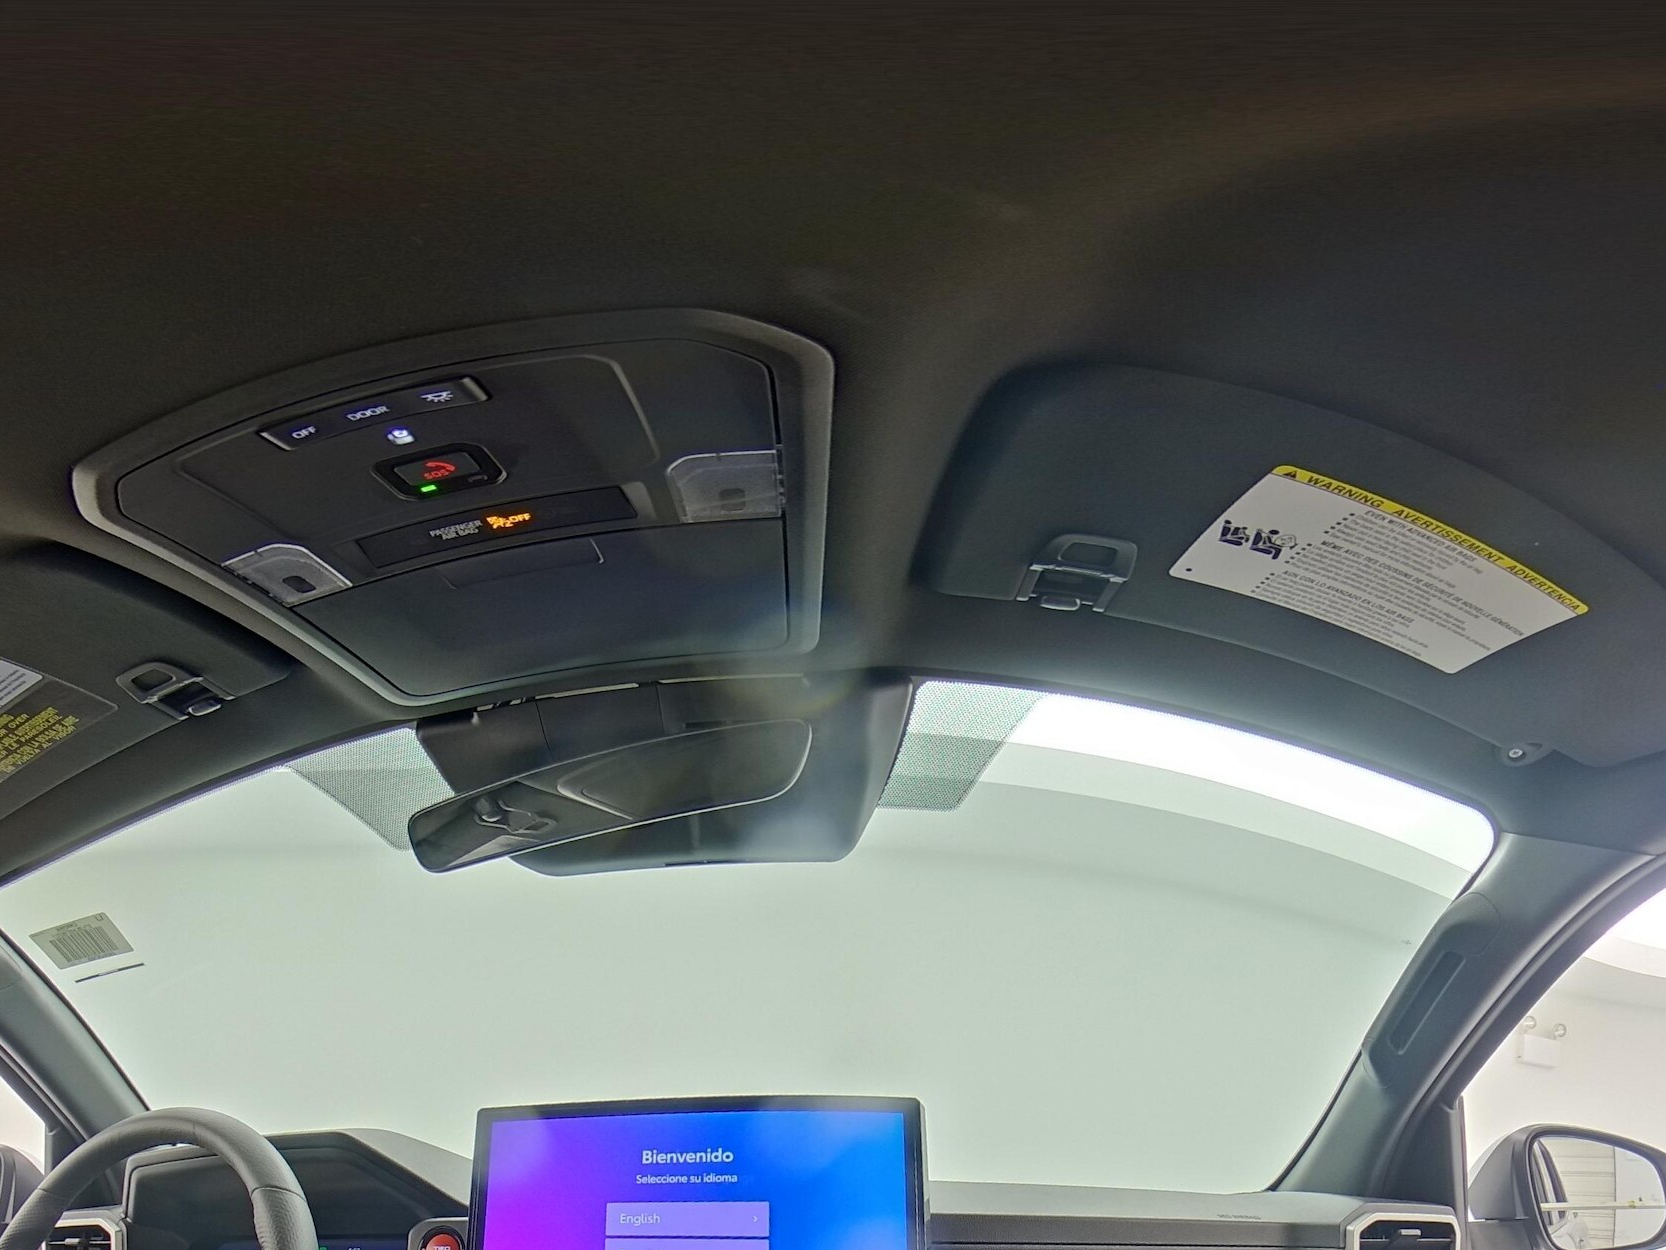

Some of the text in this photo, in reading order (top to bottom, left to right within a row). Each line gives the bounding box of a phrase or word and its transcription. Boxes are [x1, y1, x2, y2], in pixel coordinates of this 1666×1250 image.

[346, 405, 390, 422] DOOR
[291, 426, 317, 439] OFF
[423, 469, 450, 480] SOS
[429, 520, 483, 538] PASSENGER
[441, 528, 479, 541] AIR BAG
[1306, 475, 1384, 508] WARNING
[1393, 508, 1502, 563] AVERTISSEMENT
[1506, 564, 1581, 612] ADVERTENCIA
[7, 713, 29, 729] OVER
[641, 1147, 734, 1165] Bienvenido
[636, 1172, 738, 1184] Seleccione su idioma
[620, 1213, 661, 1227] English
